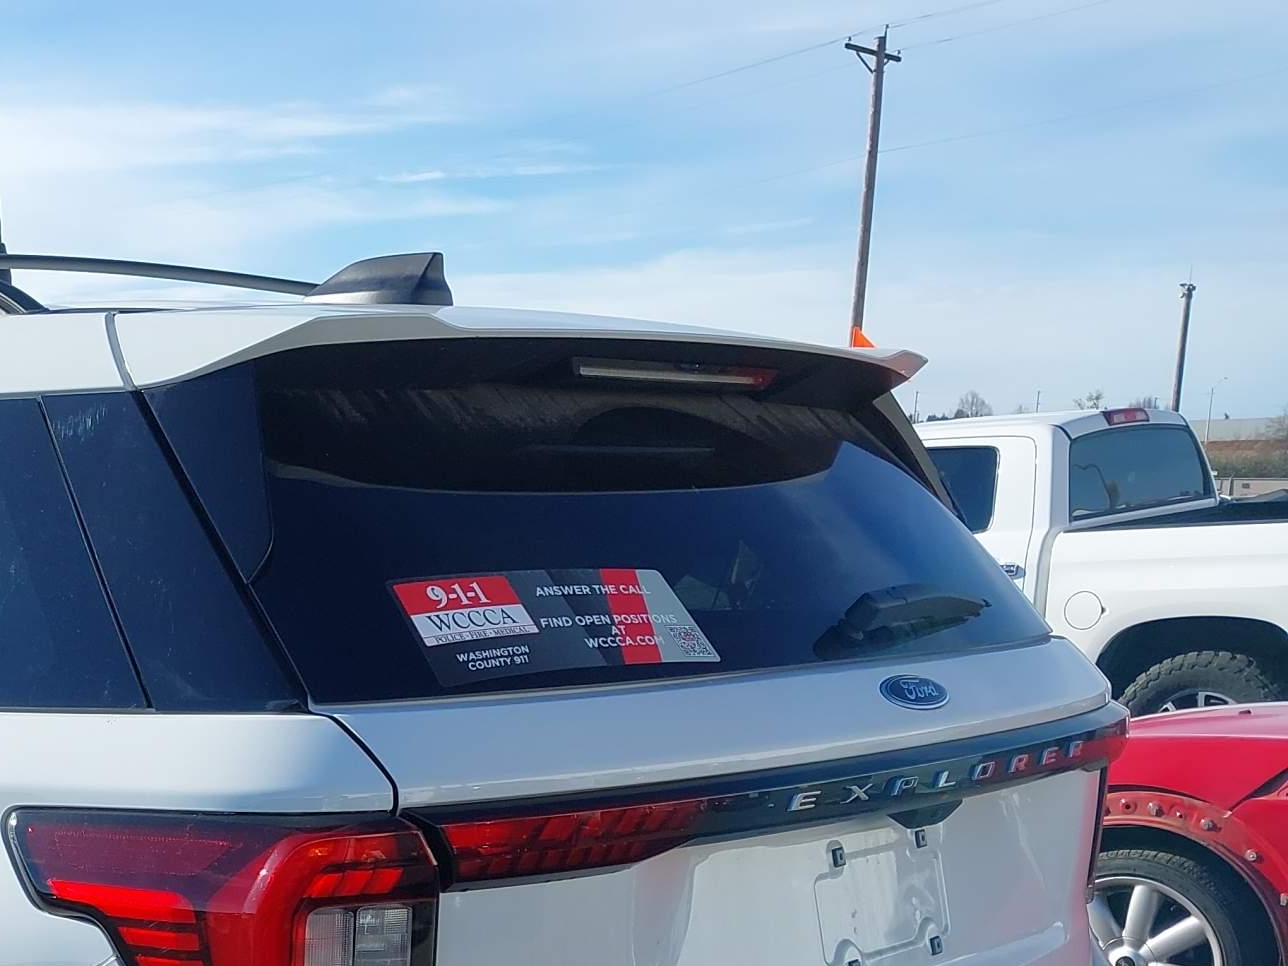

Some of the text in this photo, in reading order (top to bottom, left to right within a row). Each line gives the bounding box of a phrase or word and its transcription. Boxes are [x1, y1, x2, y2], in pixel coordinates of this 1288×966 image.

[426, 581, 492, 609] 9-1-1
[535, 584, 652, 597] ANSWER THE CALL
[425, 608, 519, 632] WCCCA
[539, 613, 678, 628] FIND OPEN POSITIONS
[611, 625, 626, 635] AT
[584, 635, 665, 648] WCCCA.COM
[456, 644, 530, 662] WASHINGTON
[468, 654, 530, 671] COUNTY 911
[786, 740, 1085, 812] EXPLORER
